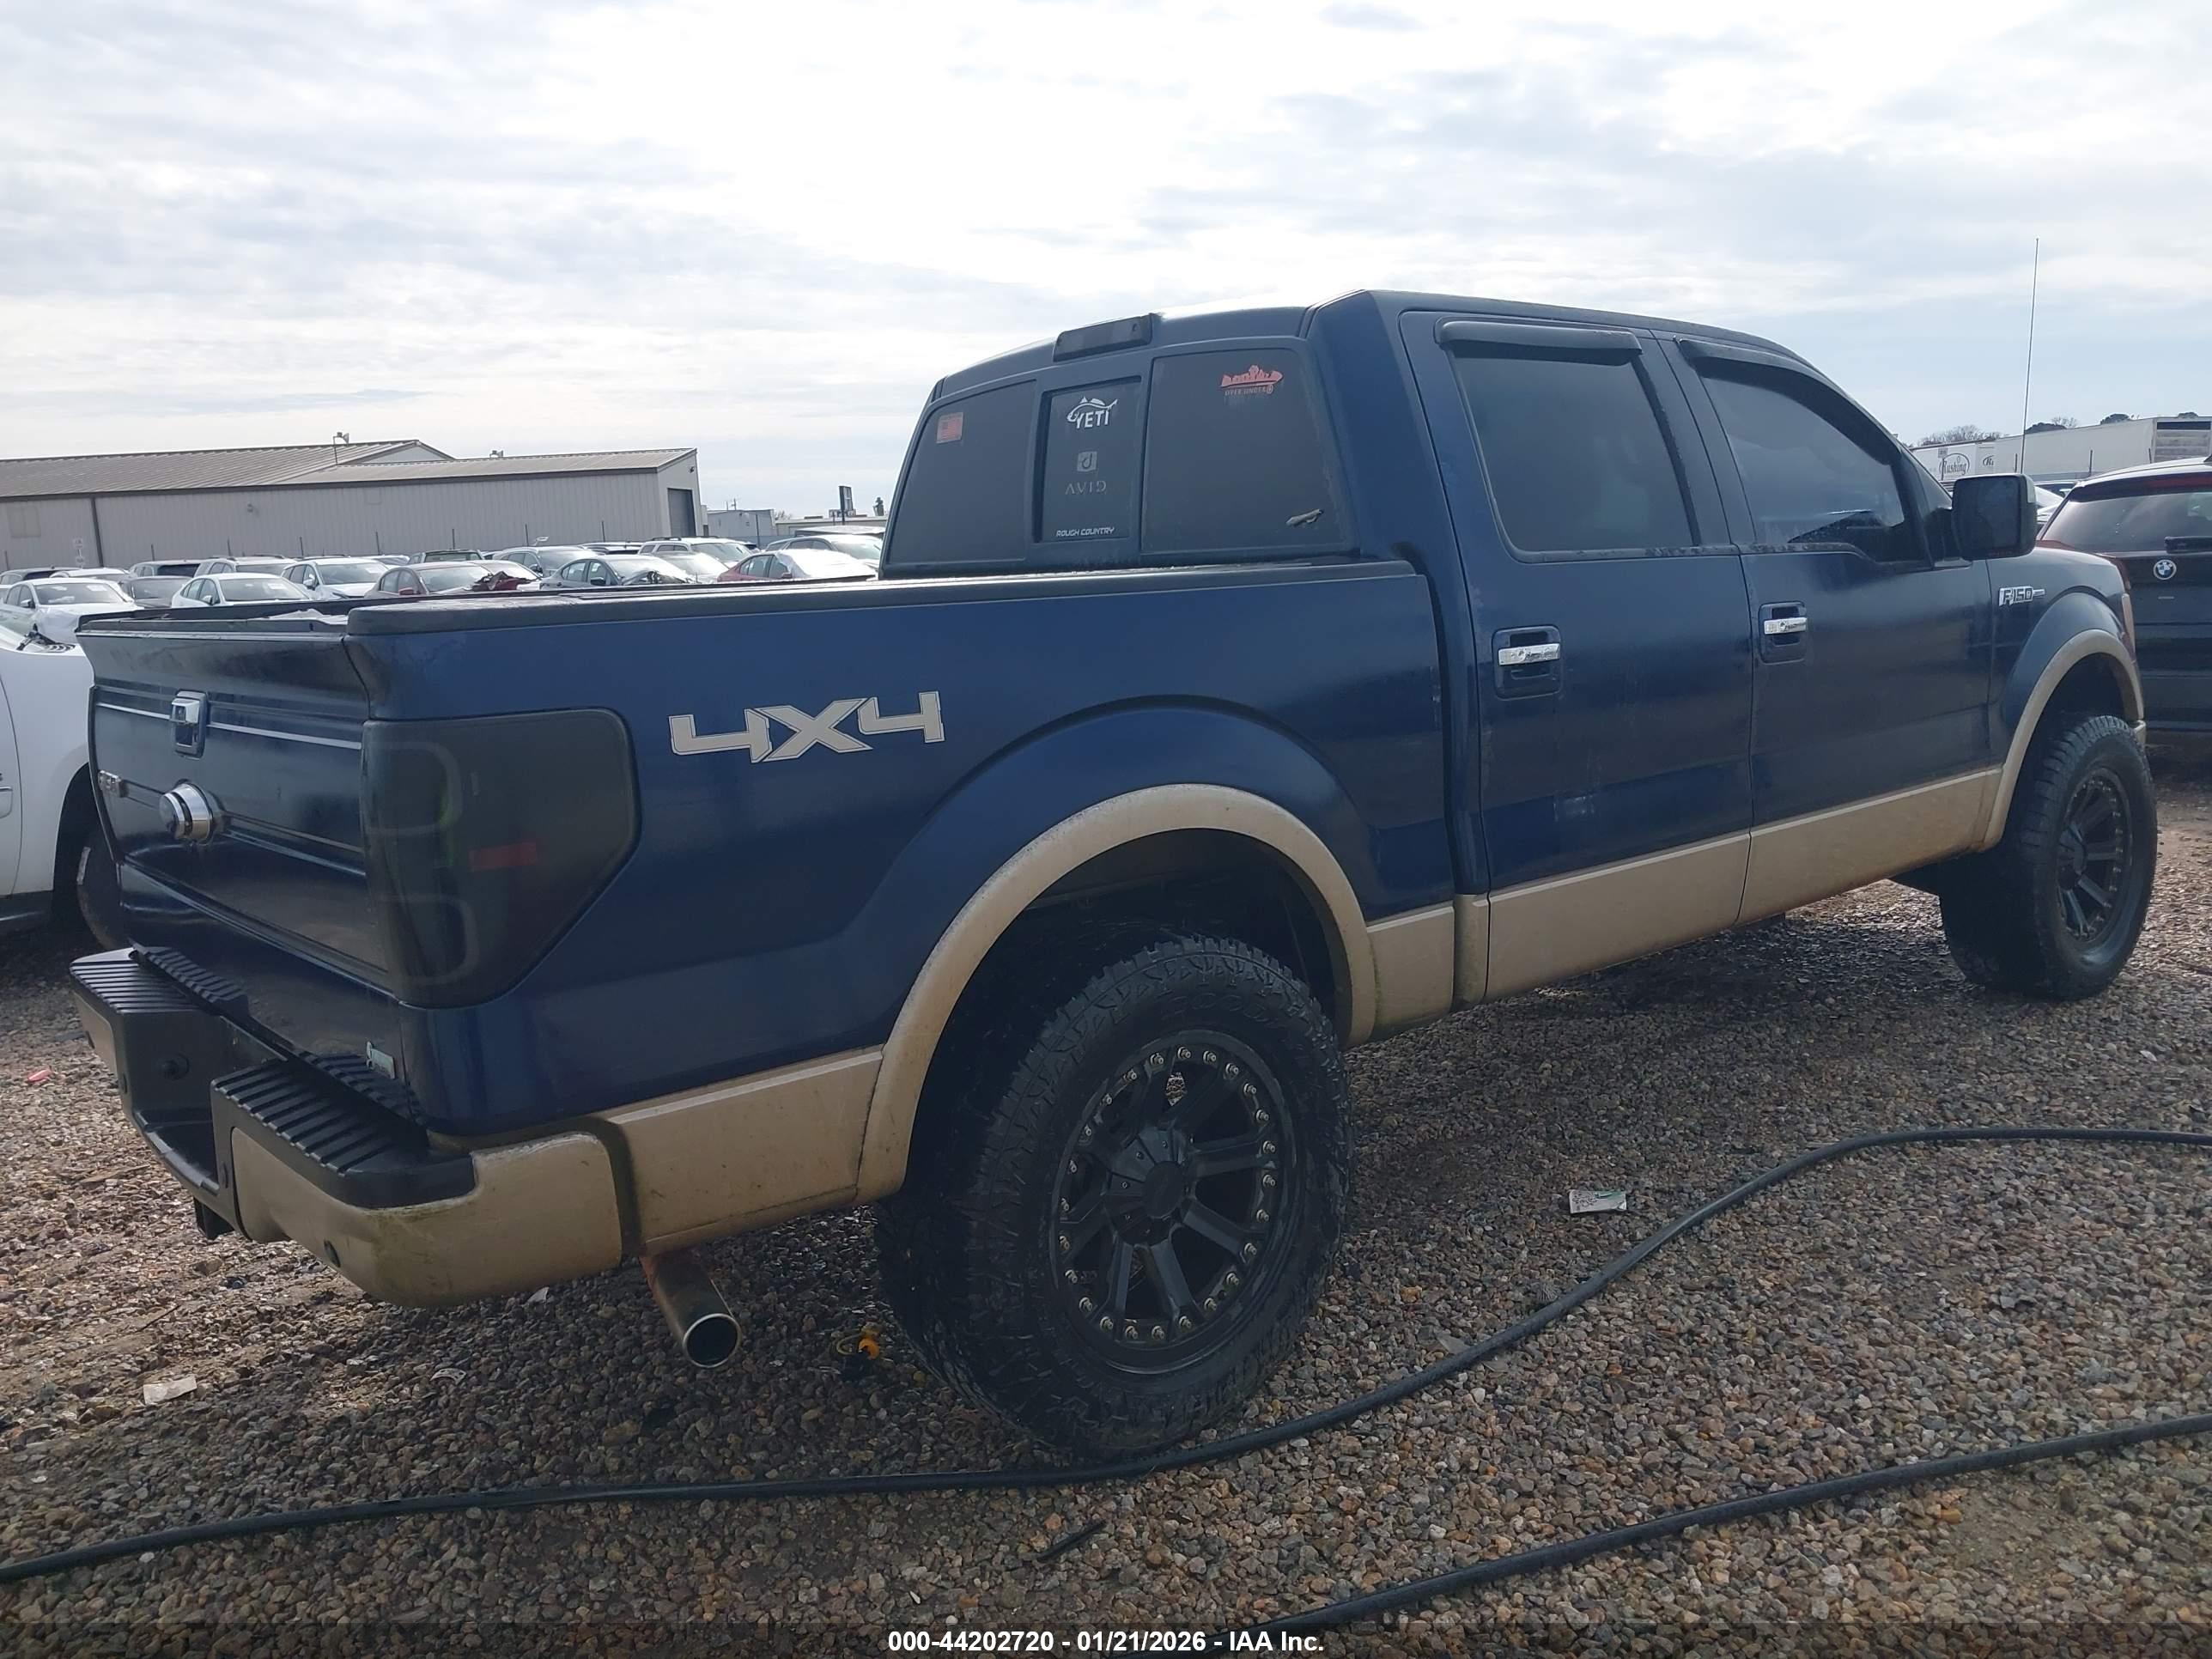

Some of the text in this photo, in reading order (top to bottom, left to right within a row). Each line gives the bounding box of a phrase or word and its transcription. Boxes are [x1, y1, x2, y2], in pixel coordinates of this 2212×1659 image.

[1075, 410, 1109, 428] YETI
[1065, 480, 1107, 495] AVID
[1080, 526, 1115, 536] COUNTRY
